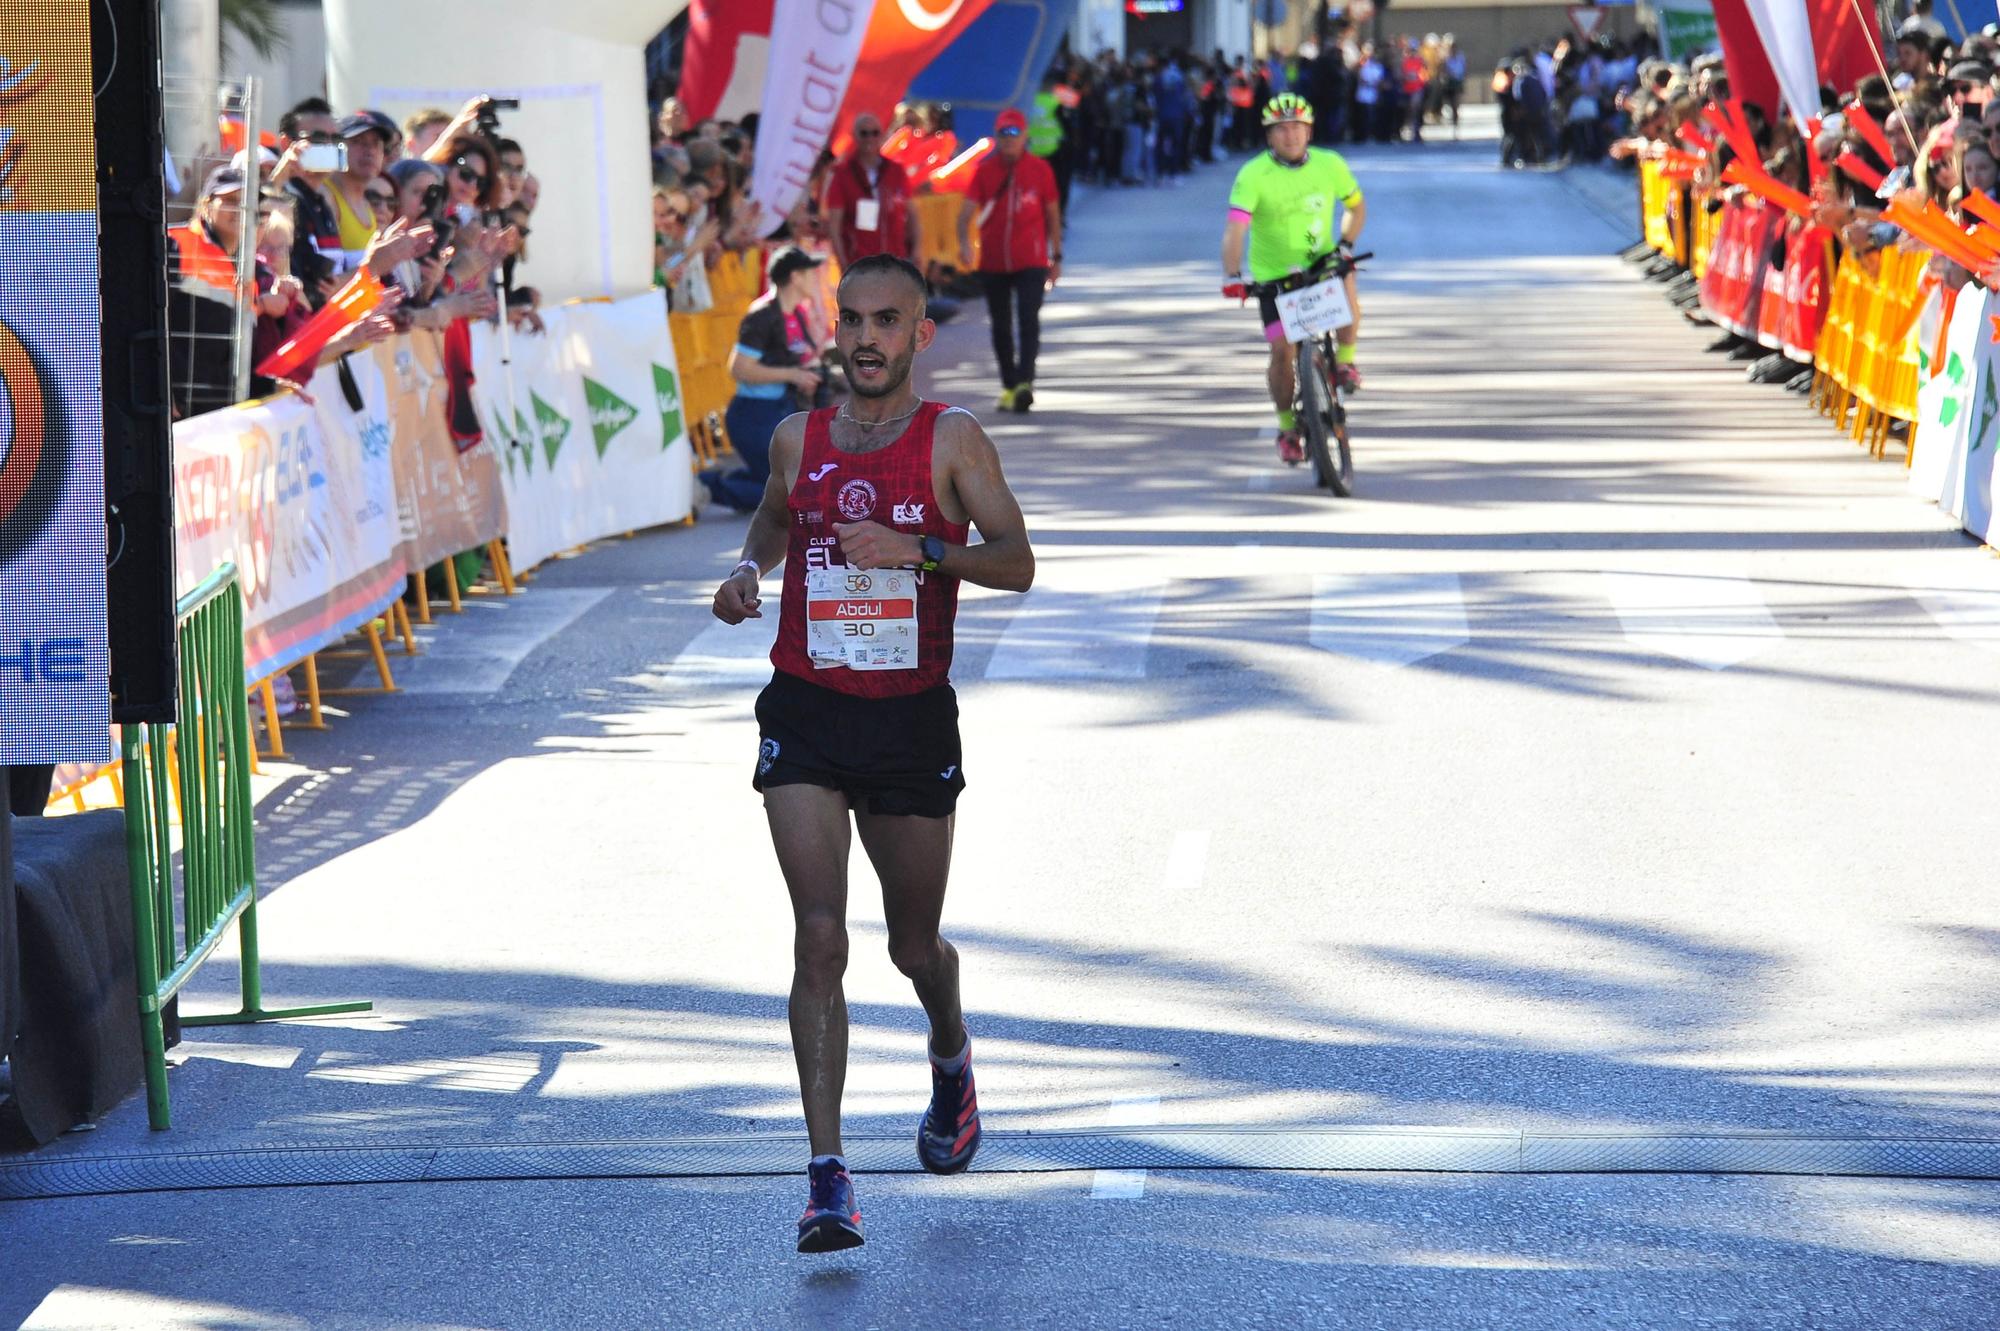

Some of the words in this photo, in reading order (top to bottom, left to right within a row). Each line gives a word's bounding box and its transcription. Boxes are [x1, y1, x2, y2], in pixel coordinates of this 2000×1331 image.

[810, 537, 836, 545] CLUB
[836, 602, 882, 617] Abdul
[844, 623, 875, 637] 30
